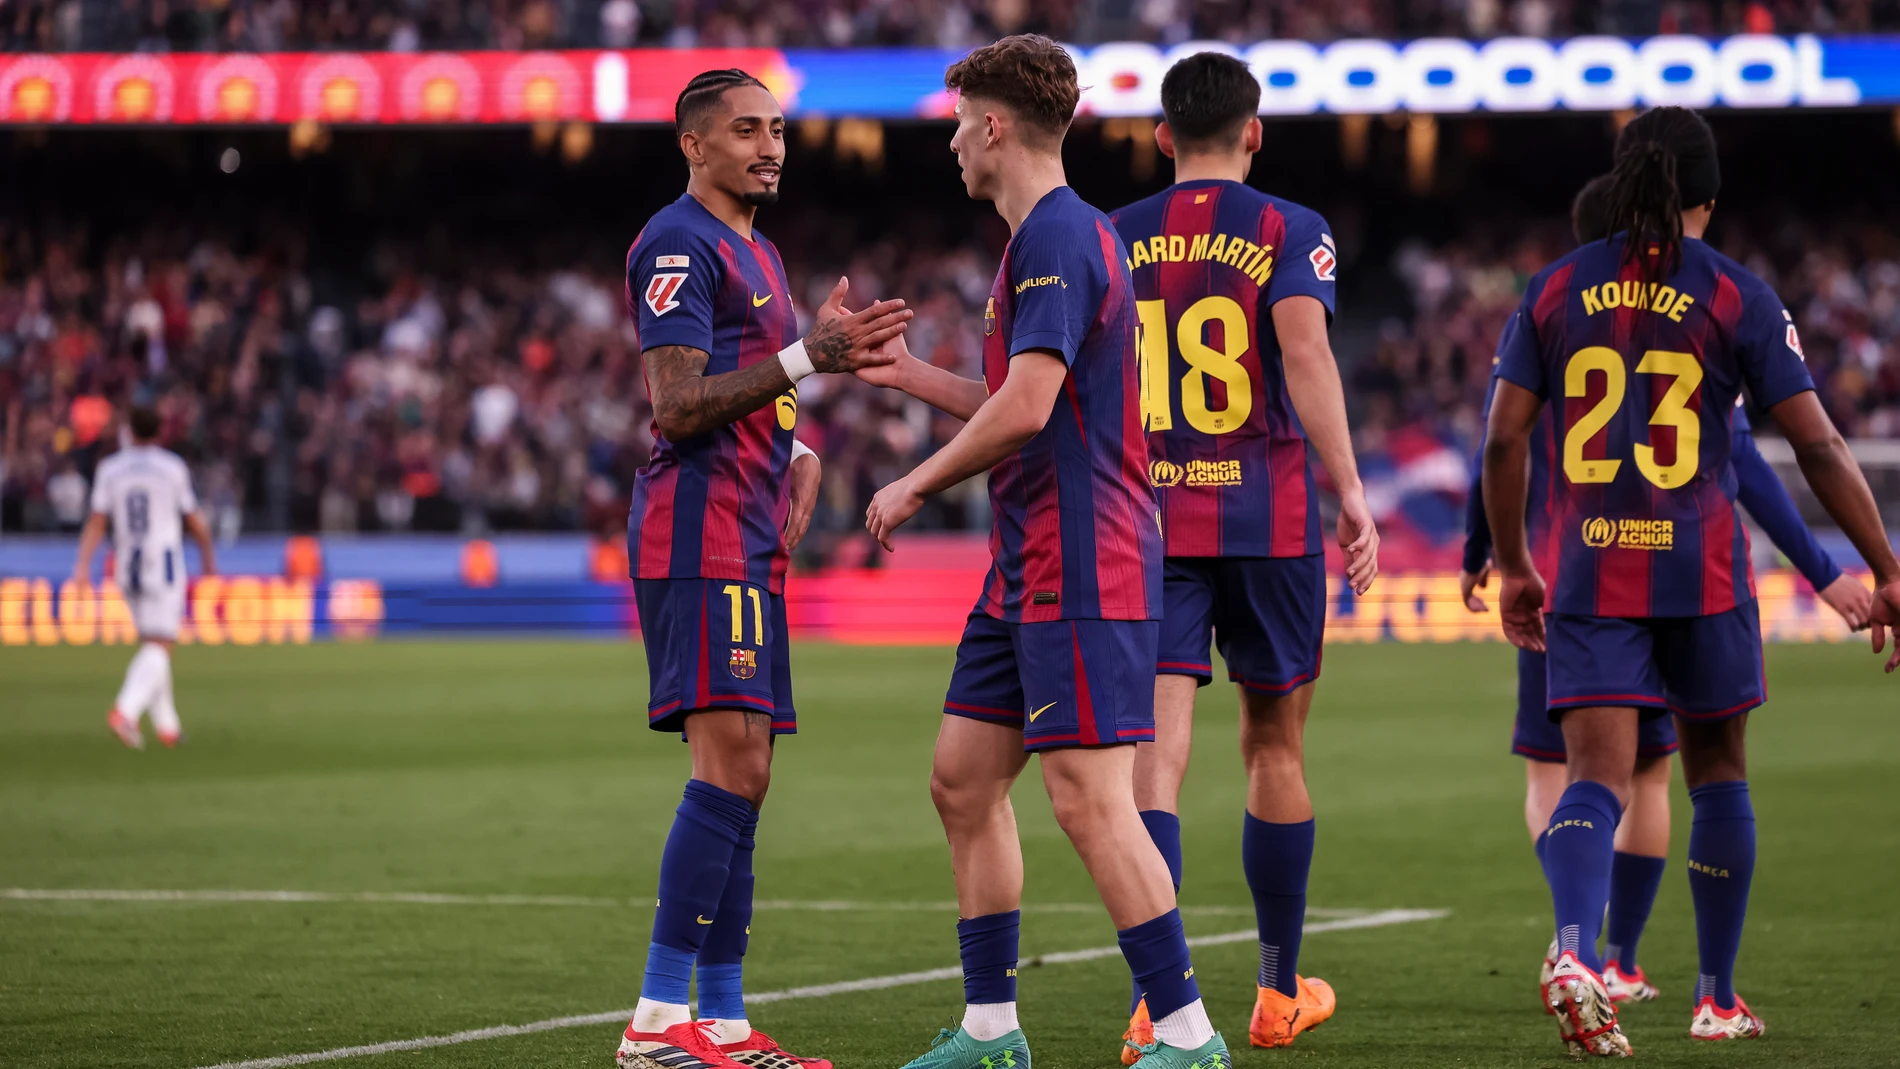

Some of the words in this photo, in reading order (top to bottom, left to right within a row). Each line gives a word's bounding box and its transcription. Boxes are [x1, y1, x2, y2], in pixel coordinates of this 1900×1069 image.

[1127, 235, 1186, 270] ARD
[1187, 233, 1273, 287] MARTÍN
[1137, 295, 1252, 435] 18
[1563, 346, 1704, 489] 23
[1185, 469, 1242, 482] ACNUR
[1186, 460, 1241, 473] UNHCR
[1618, 531, 1674, 545] ACNUR
[1619, 519, 1674, 533] UNHCR
[722, 585, 763, 647] 11
